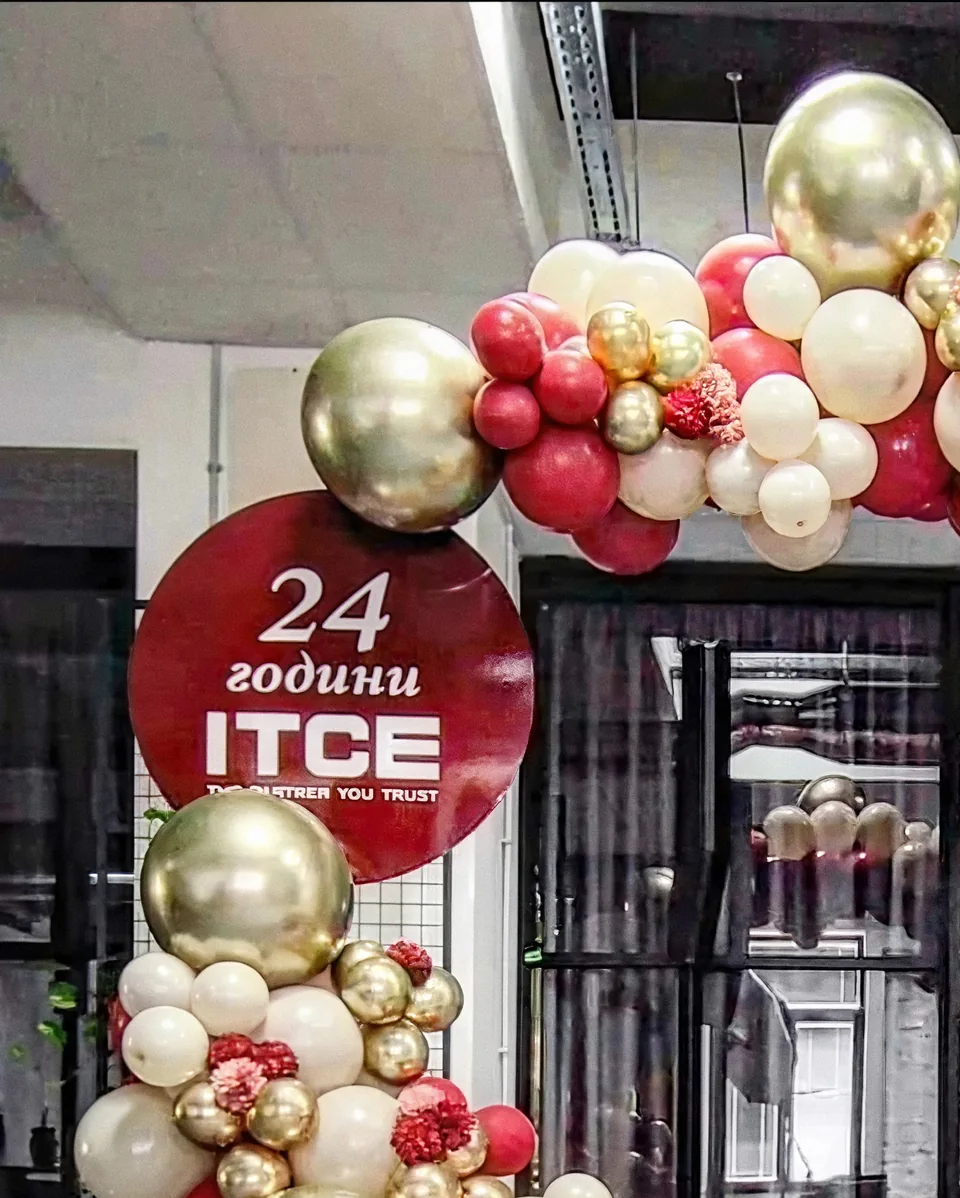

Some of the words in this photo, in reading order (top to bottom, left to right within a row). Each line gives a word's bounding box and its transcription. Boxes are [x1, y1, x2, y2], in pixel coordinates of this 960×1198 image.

[258, 566, 391, 653] 24
[225, 650, 421, 697] години
[206, 711, 441, 781] ITCE
[337, 787, 374, 801] YOU
[381, 788, 439, 803] TRUST
